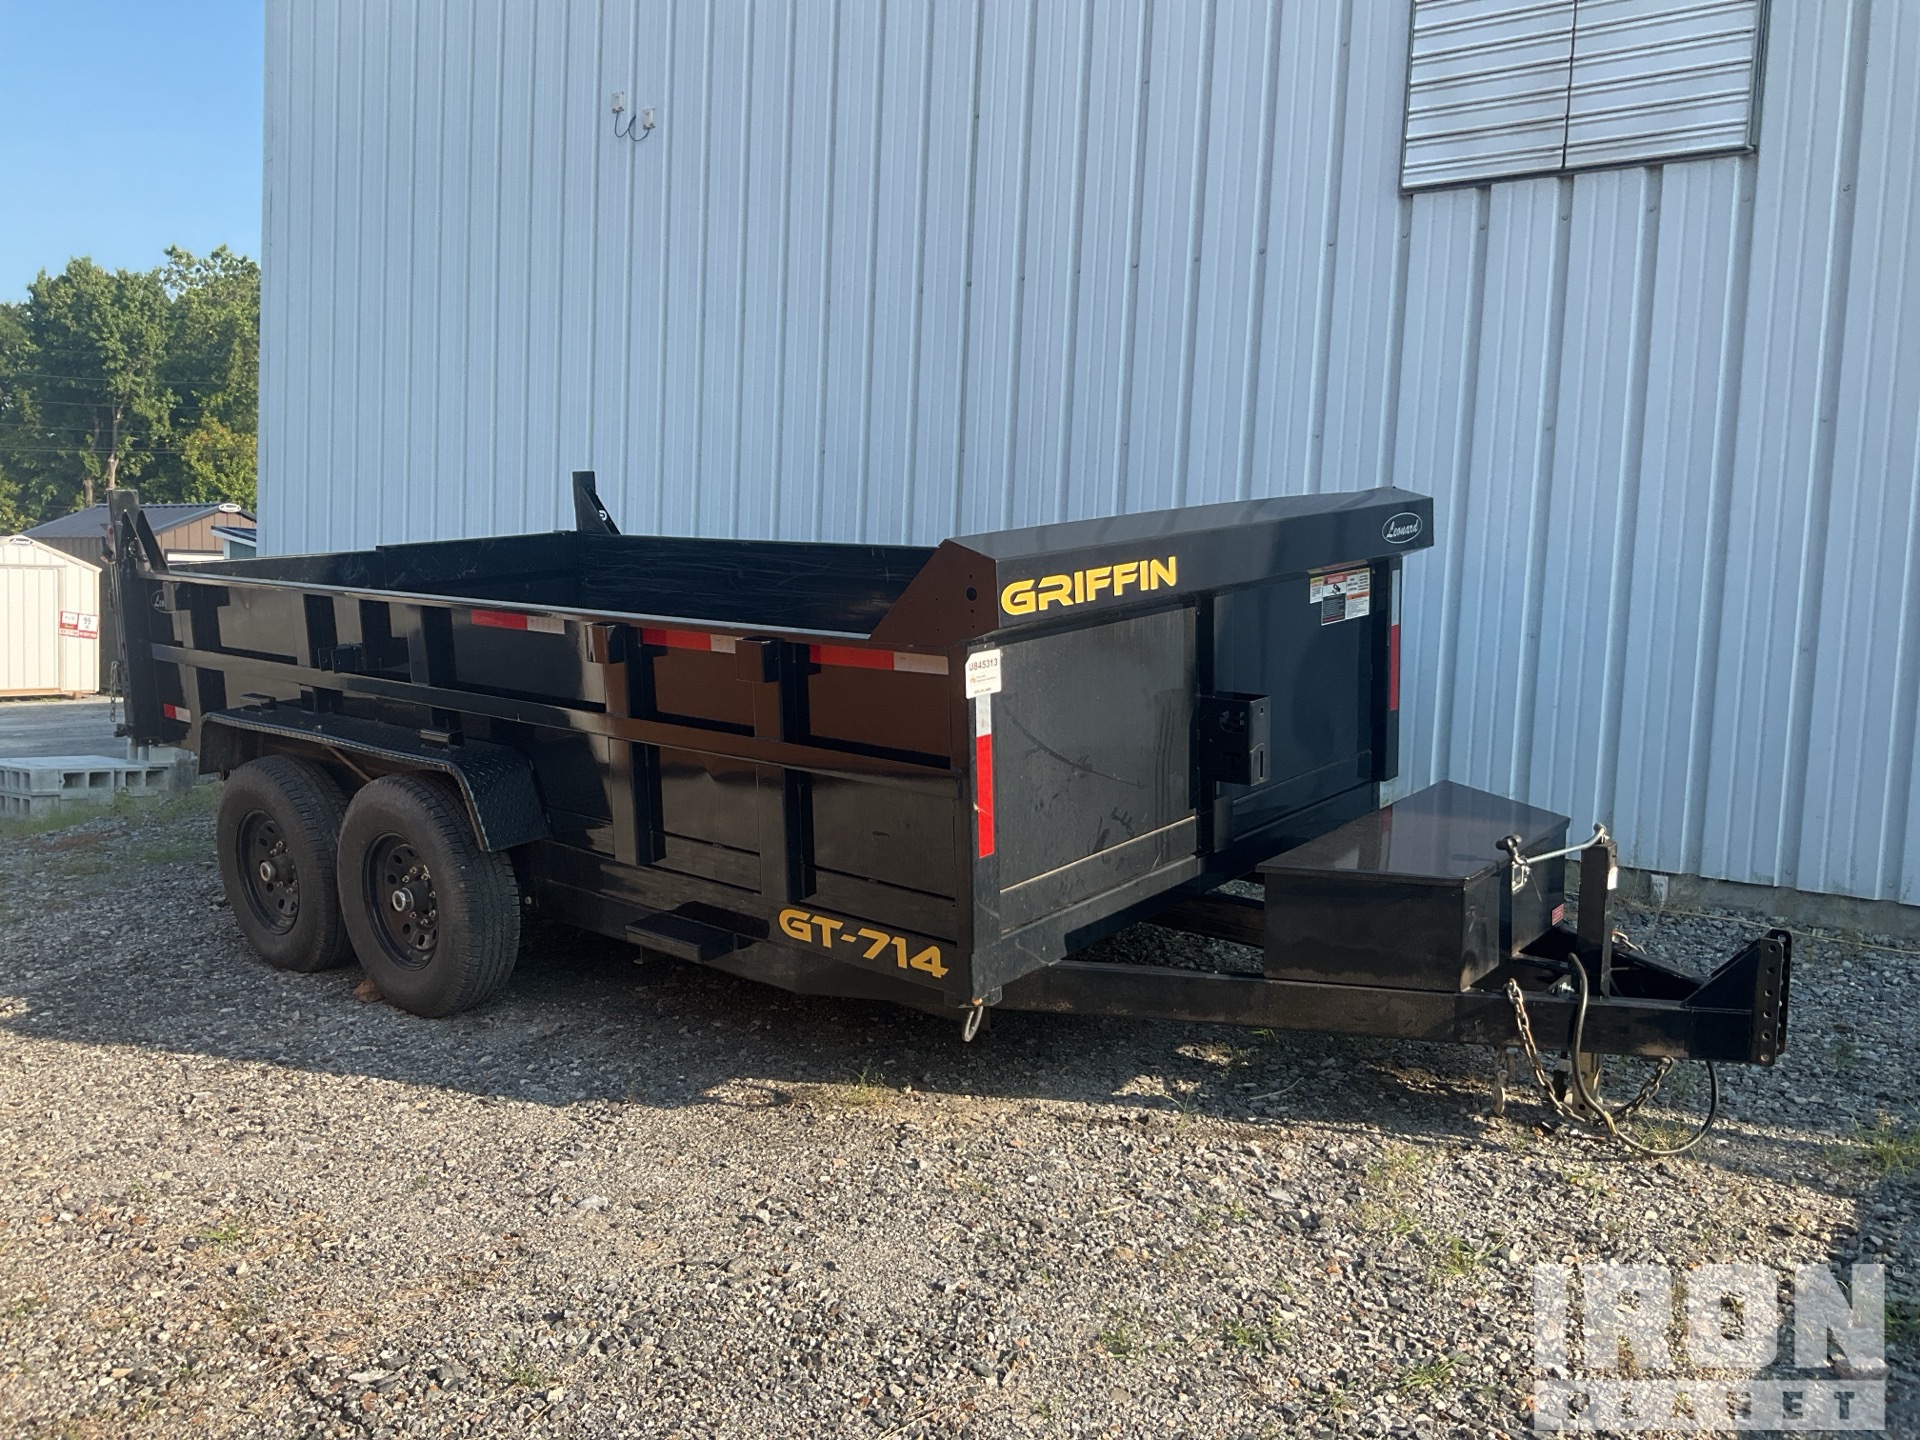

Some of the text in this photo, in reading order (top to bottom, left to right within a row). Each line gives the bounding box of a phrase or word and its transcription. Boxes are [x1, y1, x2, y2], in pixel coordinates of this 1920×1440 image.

[1001, 556, 1177, 616] GRIFFIN
[968, 658, 998, 671] U845313
[778, 908, 949, 979] GT-714
